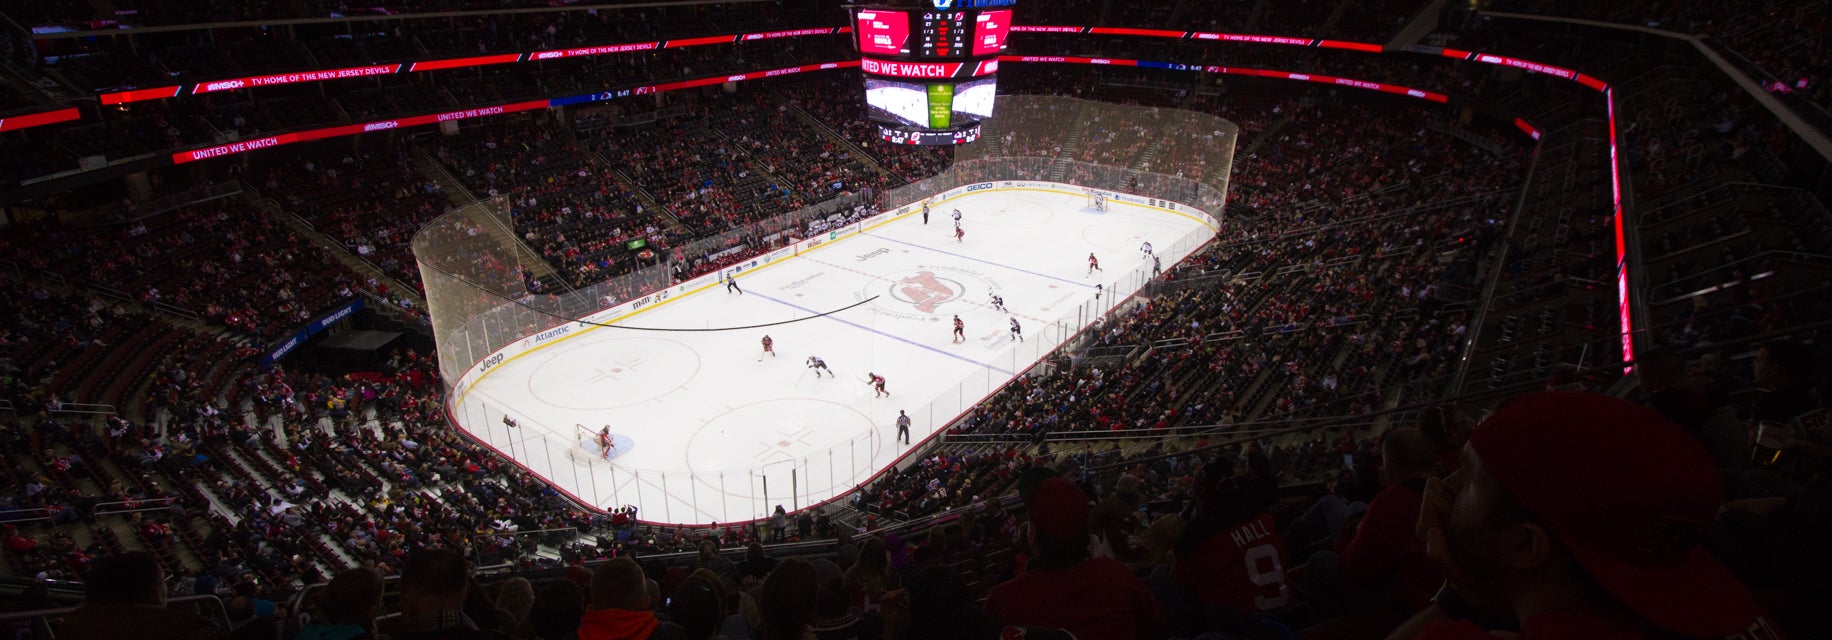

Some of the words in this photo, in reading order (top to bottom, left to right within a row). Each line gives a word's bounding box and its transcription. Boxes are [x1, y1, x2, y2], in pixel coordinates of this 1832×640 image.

[264, 76, 287, 84] HOME
[338, 69, 363, 77] JERSEY
[881, 64, 897, 75] WE
[900, 64, 944, 76] WATCH
[438, 112, 464, 122] UNITED
[479, 107, 503, 115] WATCH
[193, 147, 227, 159] UNITED
[230, 143, 245, 152] WE
[247, 138, 278, 149] WATCH
[967, 183, 992, 192] GEICO
[896, 206, 910, 215] Jeep
[857, 247, 889, 262] Jeep
[322, 316, 335, 326] BUD
[335, 306, 352, 319] LIGHT
[535, 325, 569, 343] Atlantic
[272, 349, 284, 360] BUD
[283, 338, 297, 353] LIGHT
[480, 352, 503, 372] Jeep
[1230, 520, 1270, 548] HALL
[1244, 544, 1289, 611] 9
